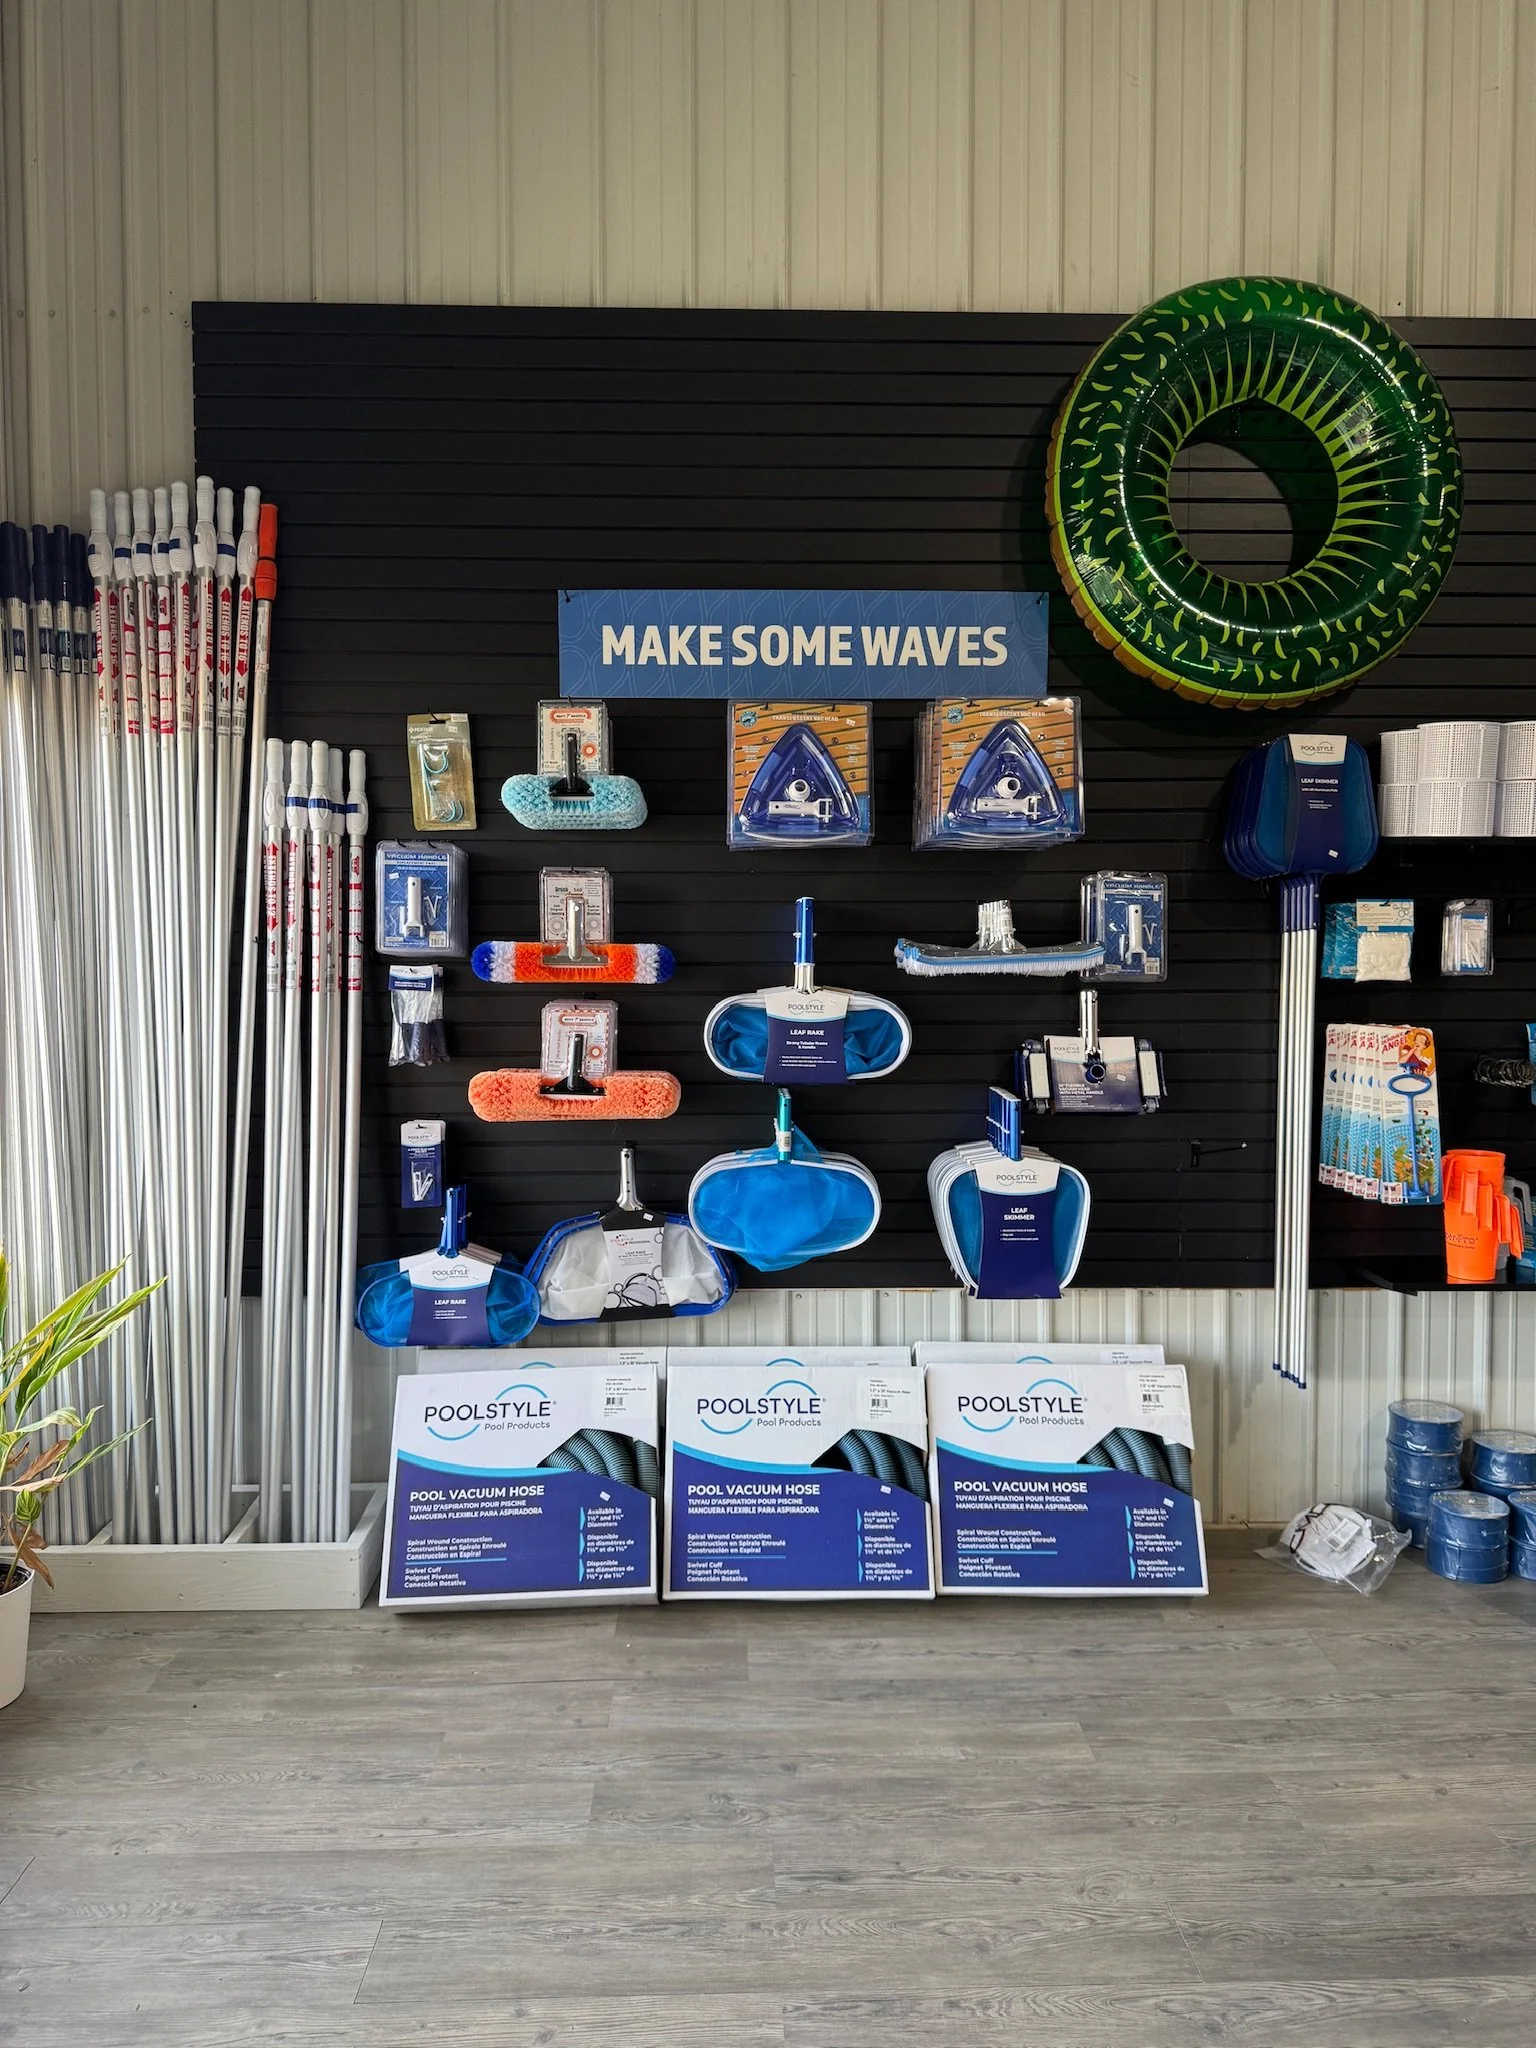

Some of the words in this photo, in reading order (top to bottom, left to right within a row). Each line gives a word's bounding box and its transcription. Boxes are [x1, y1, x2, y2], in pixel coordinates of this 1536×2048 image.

[603, 625, 722, 665] MAKE
[732, 625, 852, 666] SOME
[862, 626, 1007, 666] WAVES
[697, 1398, 821, 1414] POOLSTYLE
[958, 1396, 1083, 1413] POOLSTYLE
[424, 1401, 552, 1423] POOLSTYLE
[757, 1418, 776, 1427] Pool
[779, 1418, 821, 1427] Products
[1019, 1416, 1039, 1425] Pool
[1041, 1416, 1084, 1425] Products
[484, 1422, 504, 1431] Pool
[507, 1421, 550, 1430] Products
[688, 1485, 723, 1495] POOL
[726, 1485, 782, 1495] VACUUM
[786, 1484, 820, 1495] HOSE
[954, 1482, 990, 1492] POOL
[992, 1482, 1049, 1492] VACUUM
[1052, 1482, 1087, 1493] HOSE
[410, 1491, 446, 1502] POOL
[449, 1487, 506, 1500] VACUUM
[509, 1485, 545, 1497] HOSE
[433, 1502, 479, 1511] D'ASPIRATION
[777, 1506, 819, 1514] ASPIRADORA
[1045, 1503, 1088, 1511] ASPIRADORA
[500, 1507, 542, 1516] ASPIRADORA
[452, 1536, 492, 1544] Construction
[459, 1550, 481, 1559] Espiral
